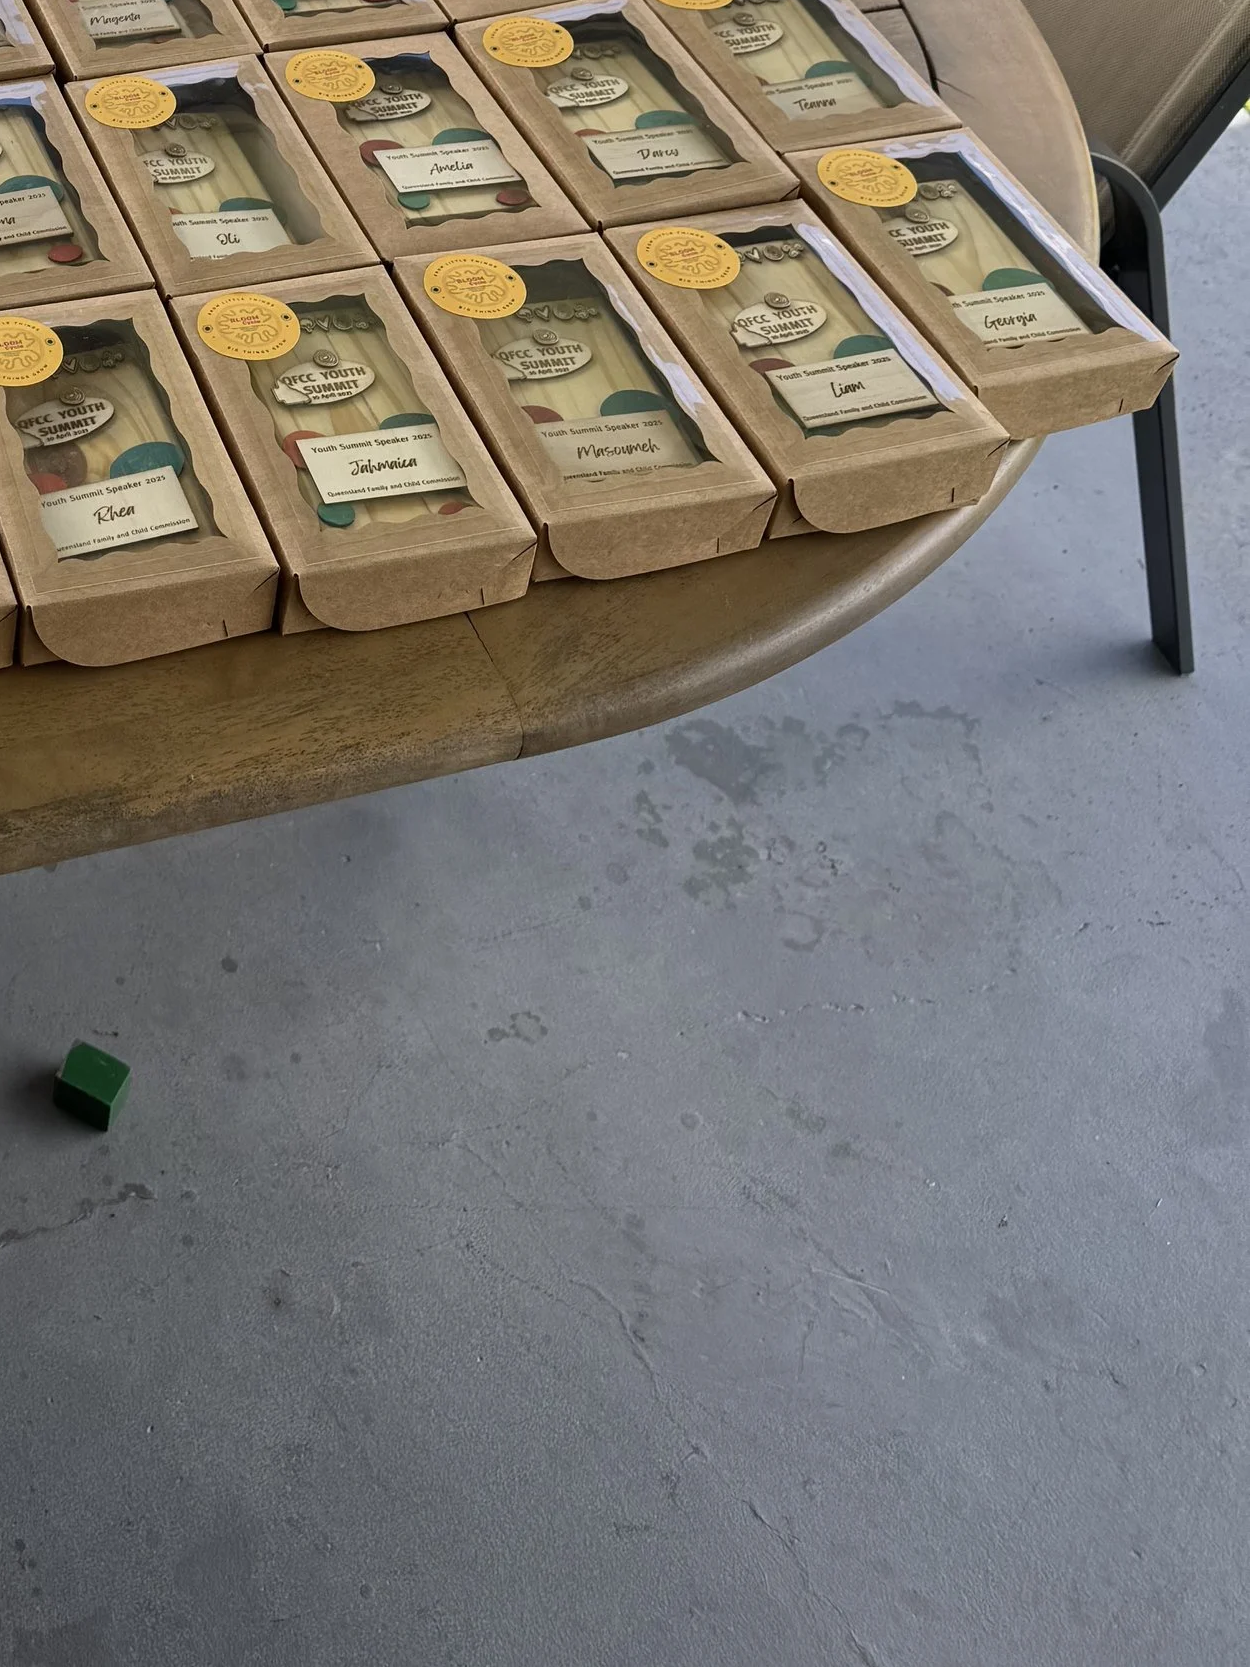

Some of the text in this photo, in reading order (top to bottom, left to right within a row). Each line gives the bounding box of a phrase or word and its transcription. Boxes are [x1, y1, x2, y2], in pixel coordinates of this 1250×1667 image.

[90, 12, 141, 26] Magenta
[738, 23, 775, 36] YOUTH
[725, 34, 772, 47] SUMMIT
[581, 78, 621, 89] YOUTH
[386, 92, 423, 104] YOUTH
[569, 88, 616, 100] SUMMIT
[370, 102, 418, 114] SUMMIT
[168, 157, 208, 166] YOUTH
[429, 161, 474, 175] Amelia
[154, 166, 202, 176] SUMMIT
[909, 221, 950, 235] YOUTH
[216, 233, 241, 246] Oli
[772, 304, 818, 320] YOUTH
[760, 318, 815, 336] SUMMIT
[984, 312, 1038, 332] Georgia
[499, 344, 584, 361] QFCC YOUTH
[520, 356, 577, 370] SUMMIT
[837, 360, 870, 372] Speaker
[282, 366, 366, 387] QFCC YOUTH
[302, 379, 360, 395] SUMMIT
[830, 380, 866, 398] Liam
[18, 401, 107, 430] QFCC YOUTH
[38, 415, 97, 437] SUMMIT
[541, 429, 568, 439] Youth
[310, 435, 409, 454] Youth Summit Speaker
[577, 438, 661, 460] Masoumeh
[348, 456, 418, 477] Jahmaica
[69, 475, 167, 503] Summit Speaker 2025
[93, 505, 136, 525] Rhea
[150, 518, 191, 532] Commission
